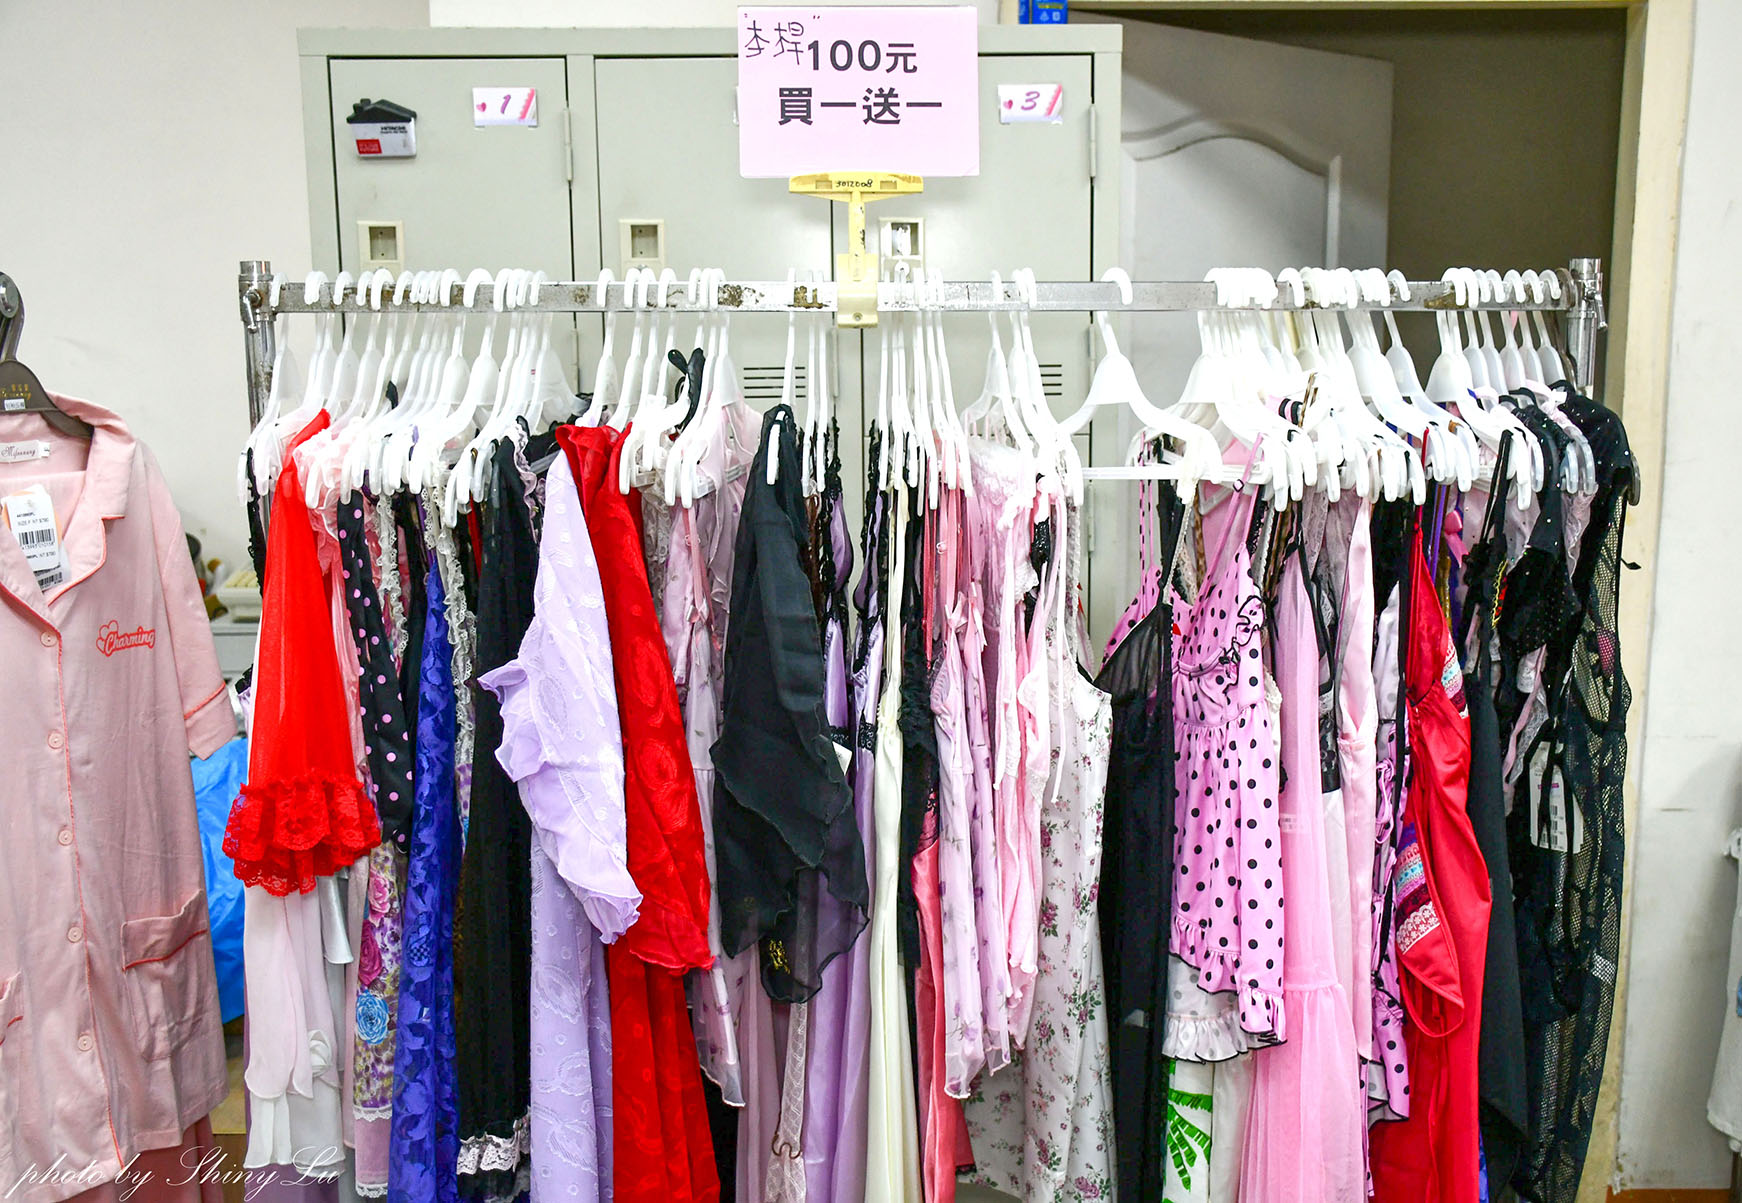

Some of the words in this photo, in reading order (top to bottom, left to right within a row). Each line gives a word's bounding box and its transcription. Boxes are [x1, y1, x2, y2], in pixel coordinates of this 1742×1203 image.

[807, 39, 918, 74] 100元
[500, 94, 511, 114] 1
[778, 87, 943, 126] 買一送一
[1020, 91, 1041, 111] 3
[104, 626, 156, 657] Charming
